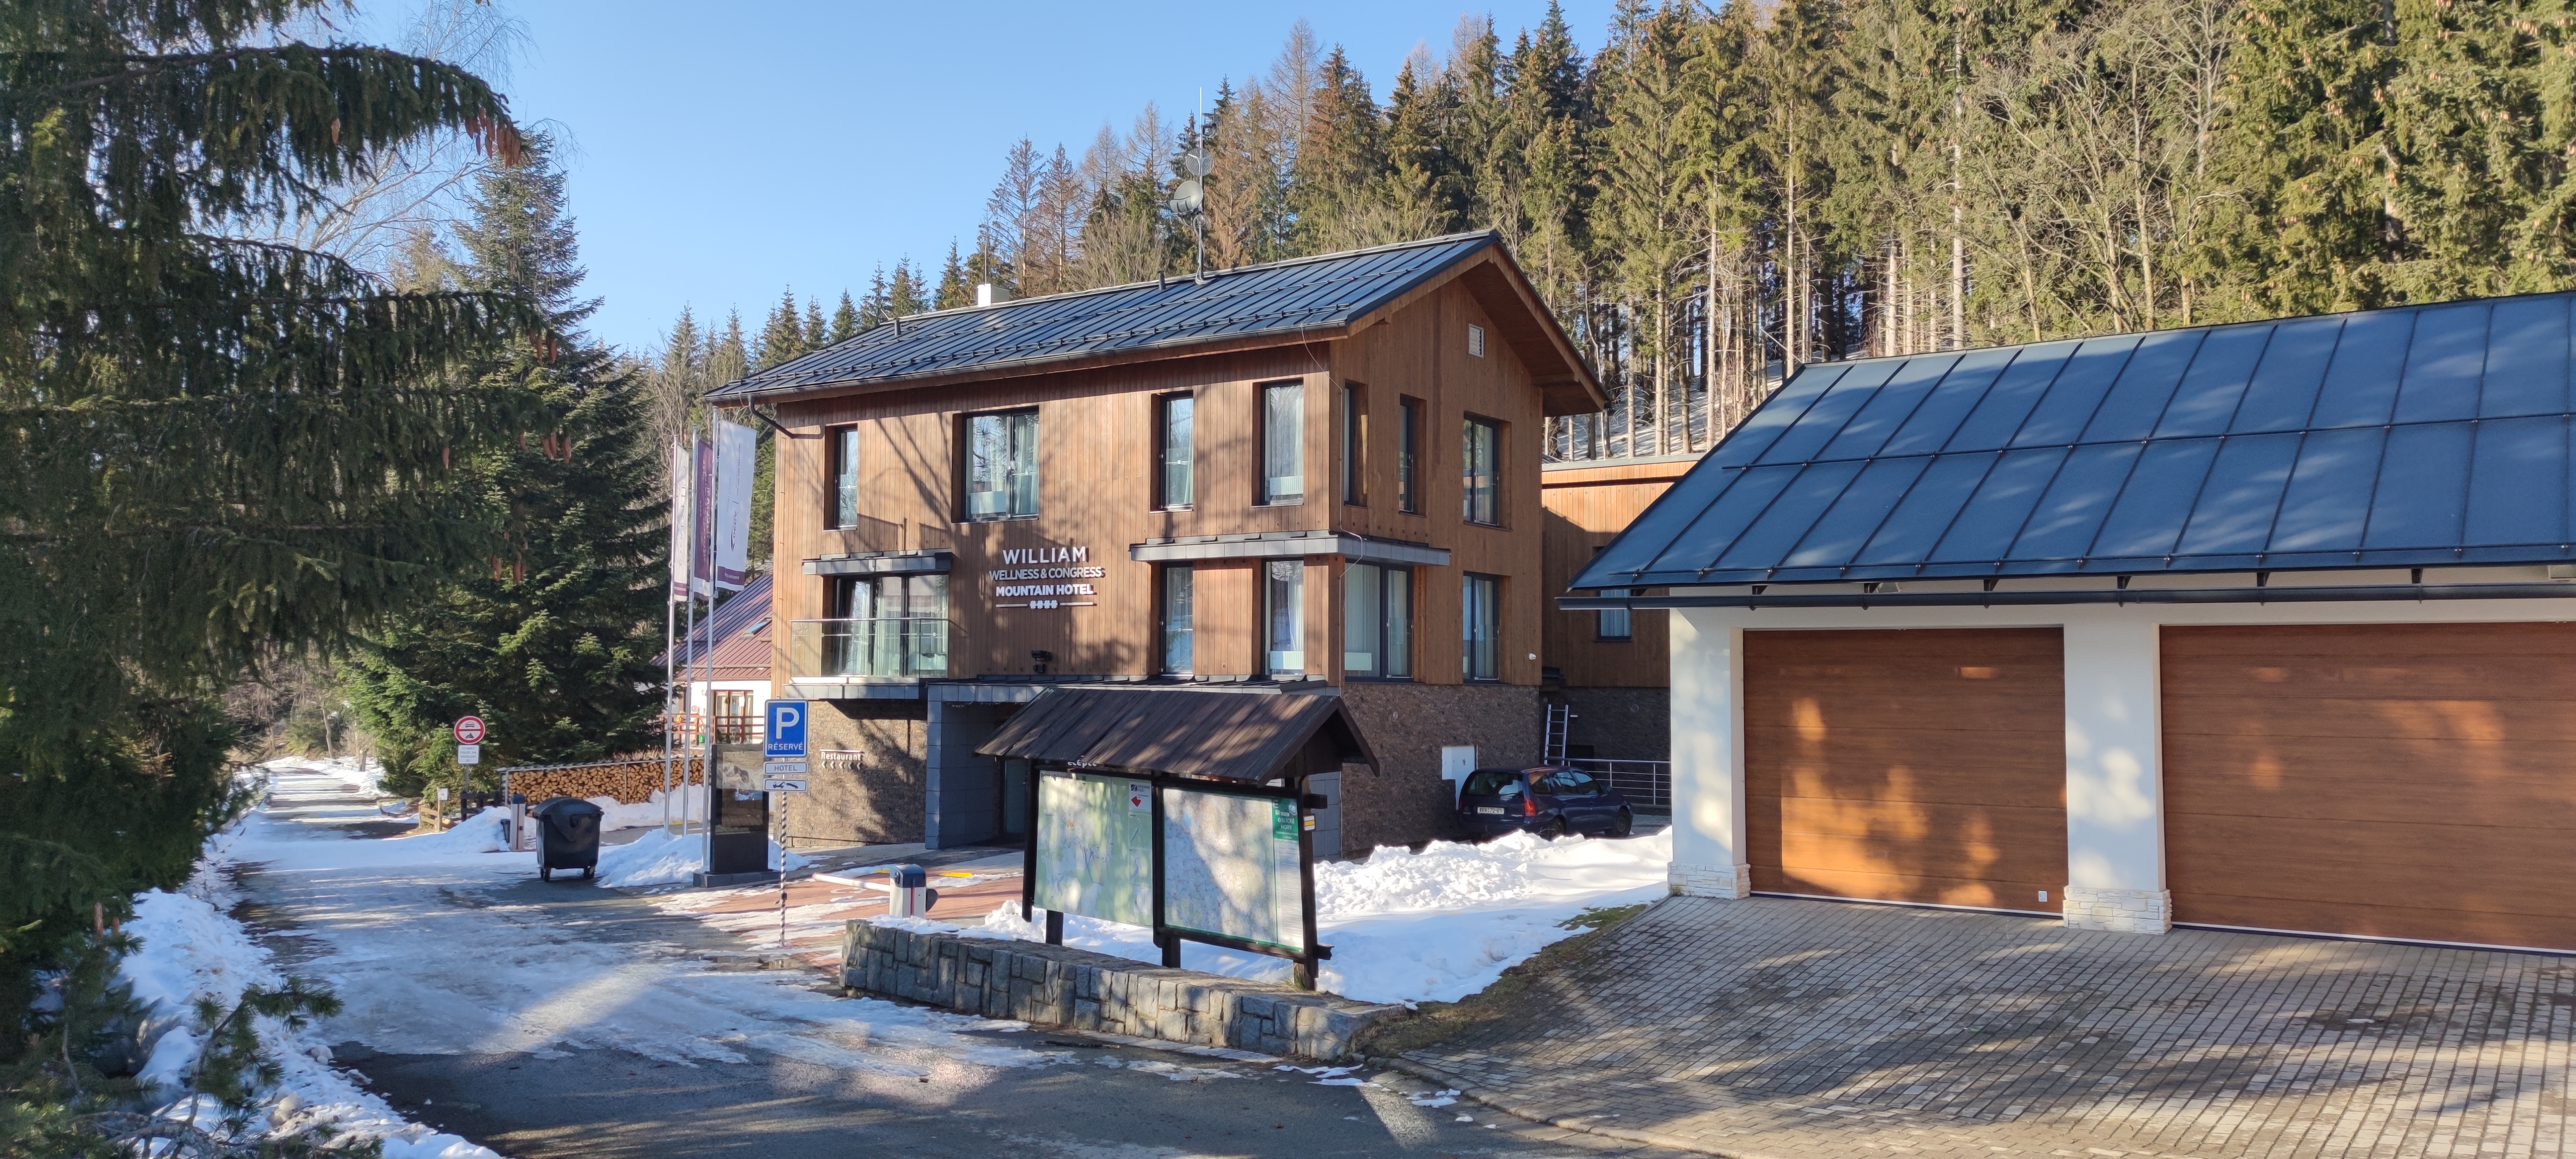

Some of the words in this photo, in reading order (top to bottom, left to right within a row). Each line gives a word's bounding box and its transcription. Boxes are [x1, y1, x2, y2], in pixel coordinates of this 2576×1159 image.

[1003, 546, 1086, 564] WILLIAM
[989, 568, 1039, 581] WELLNESS
[1040, 568, 1047, 579] &
[1048, 566, 1102, 578] CONGRESS
[996, 584, 1054, 596] MOUNTAIN
[1056, 584, 1093, 595] HOTEL
[776, 707, 800, 739] P
[768, 742, 803, 751] RÉSERVÉ
[821, 752, 861, 761] Restaurant
